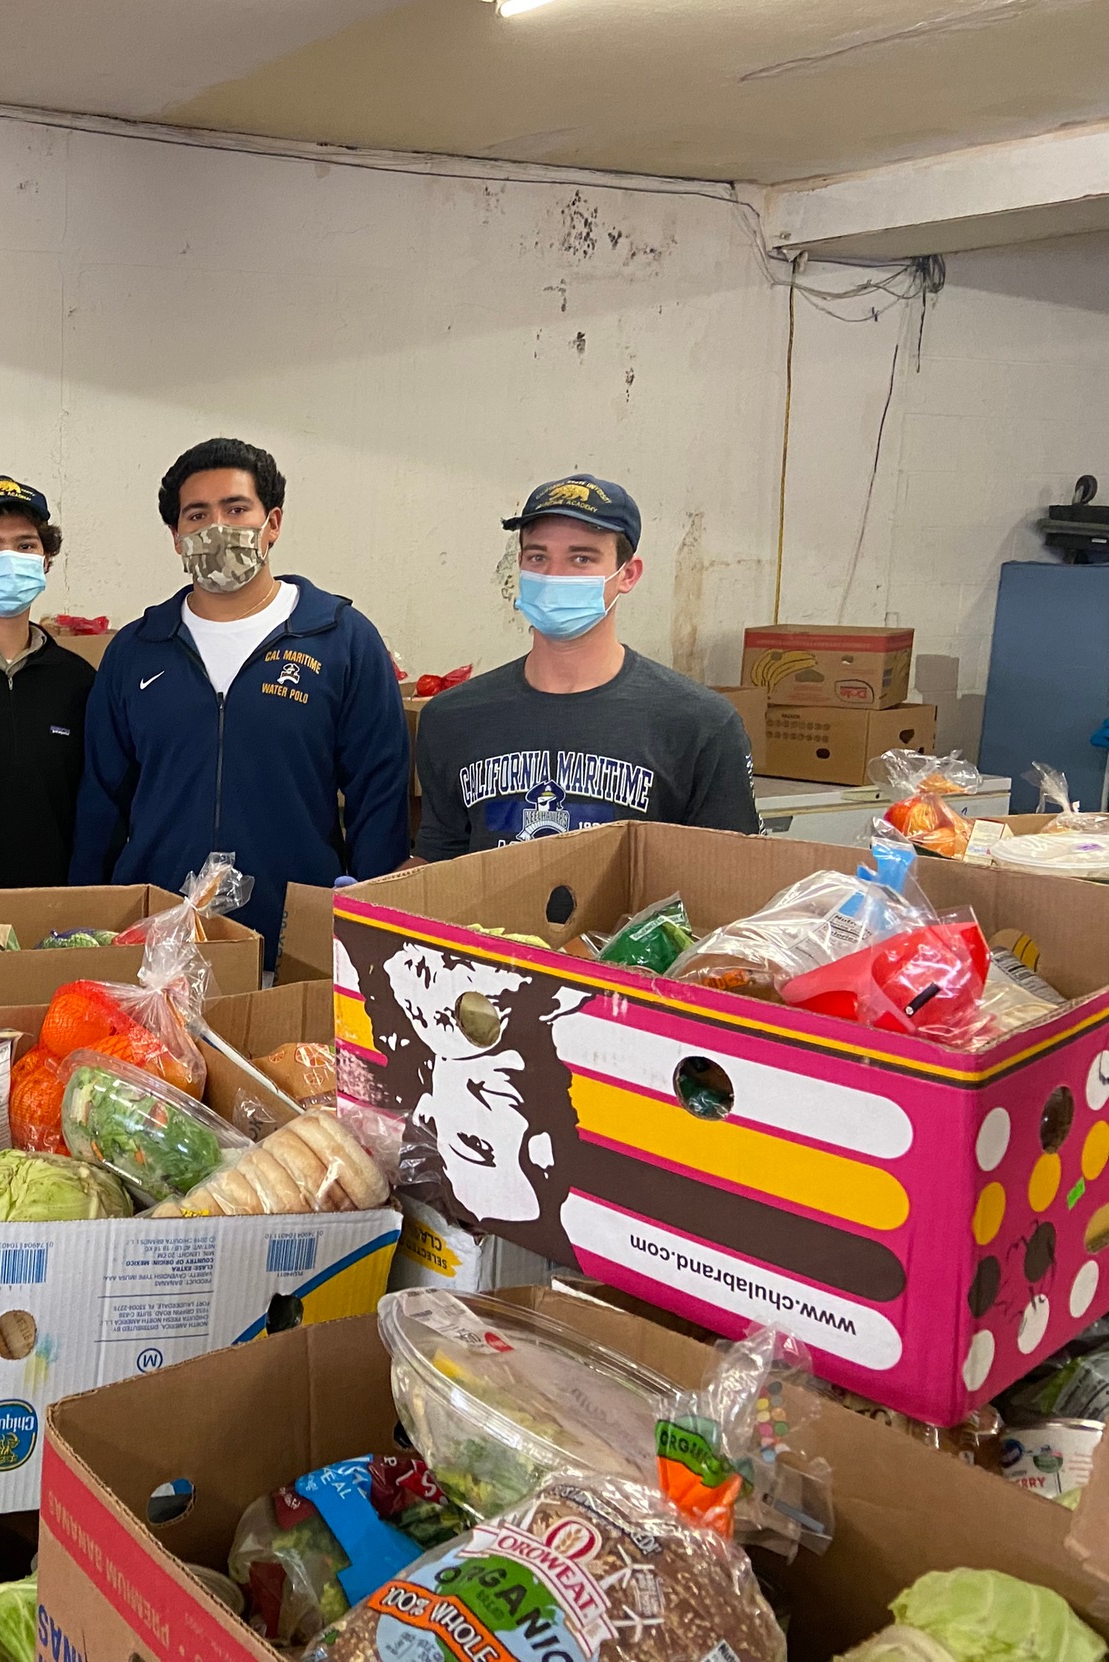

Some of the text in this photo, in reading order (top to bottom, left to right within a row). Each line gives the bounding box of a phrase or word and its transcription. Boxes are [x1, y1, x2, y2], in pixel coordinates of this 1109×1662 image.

[566, 500, 598, 513] ACADEMY
[262, 682, 309, 704] WATER POLO
[264, 650, 322, 674] CAL MARITIME
[459, 750, 654, 813] CALIFORNIA MARITIME
[629, 1234, 856, 1336] www.chulabrand.com
[105, 1554, 170, 1650] PREMIUM
[497, 1534, 598, 1612] OROWEAT
[382, 1587, 430, 1616] 100%
[430, 1601, 500, 1662] WHOLE
